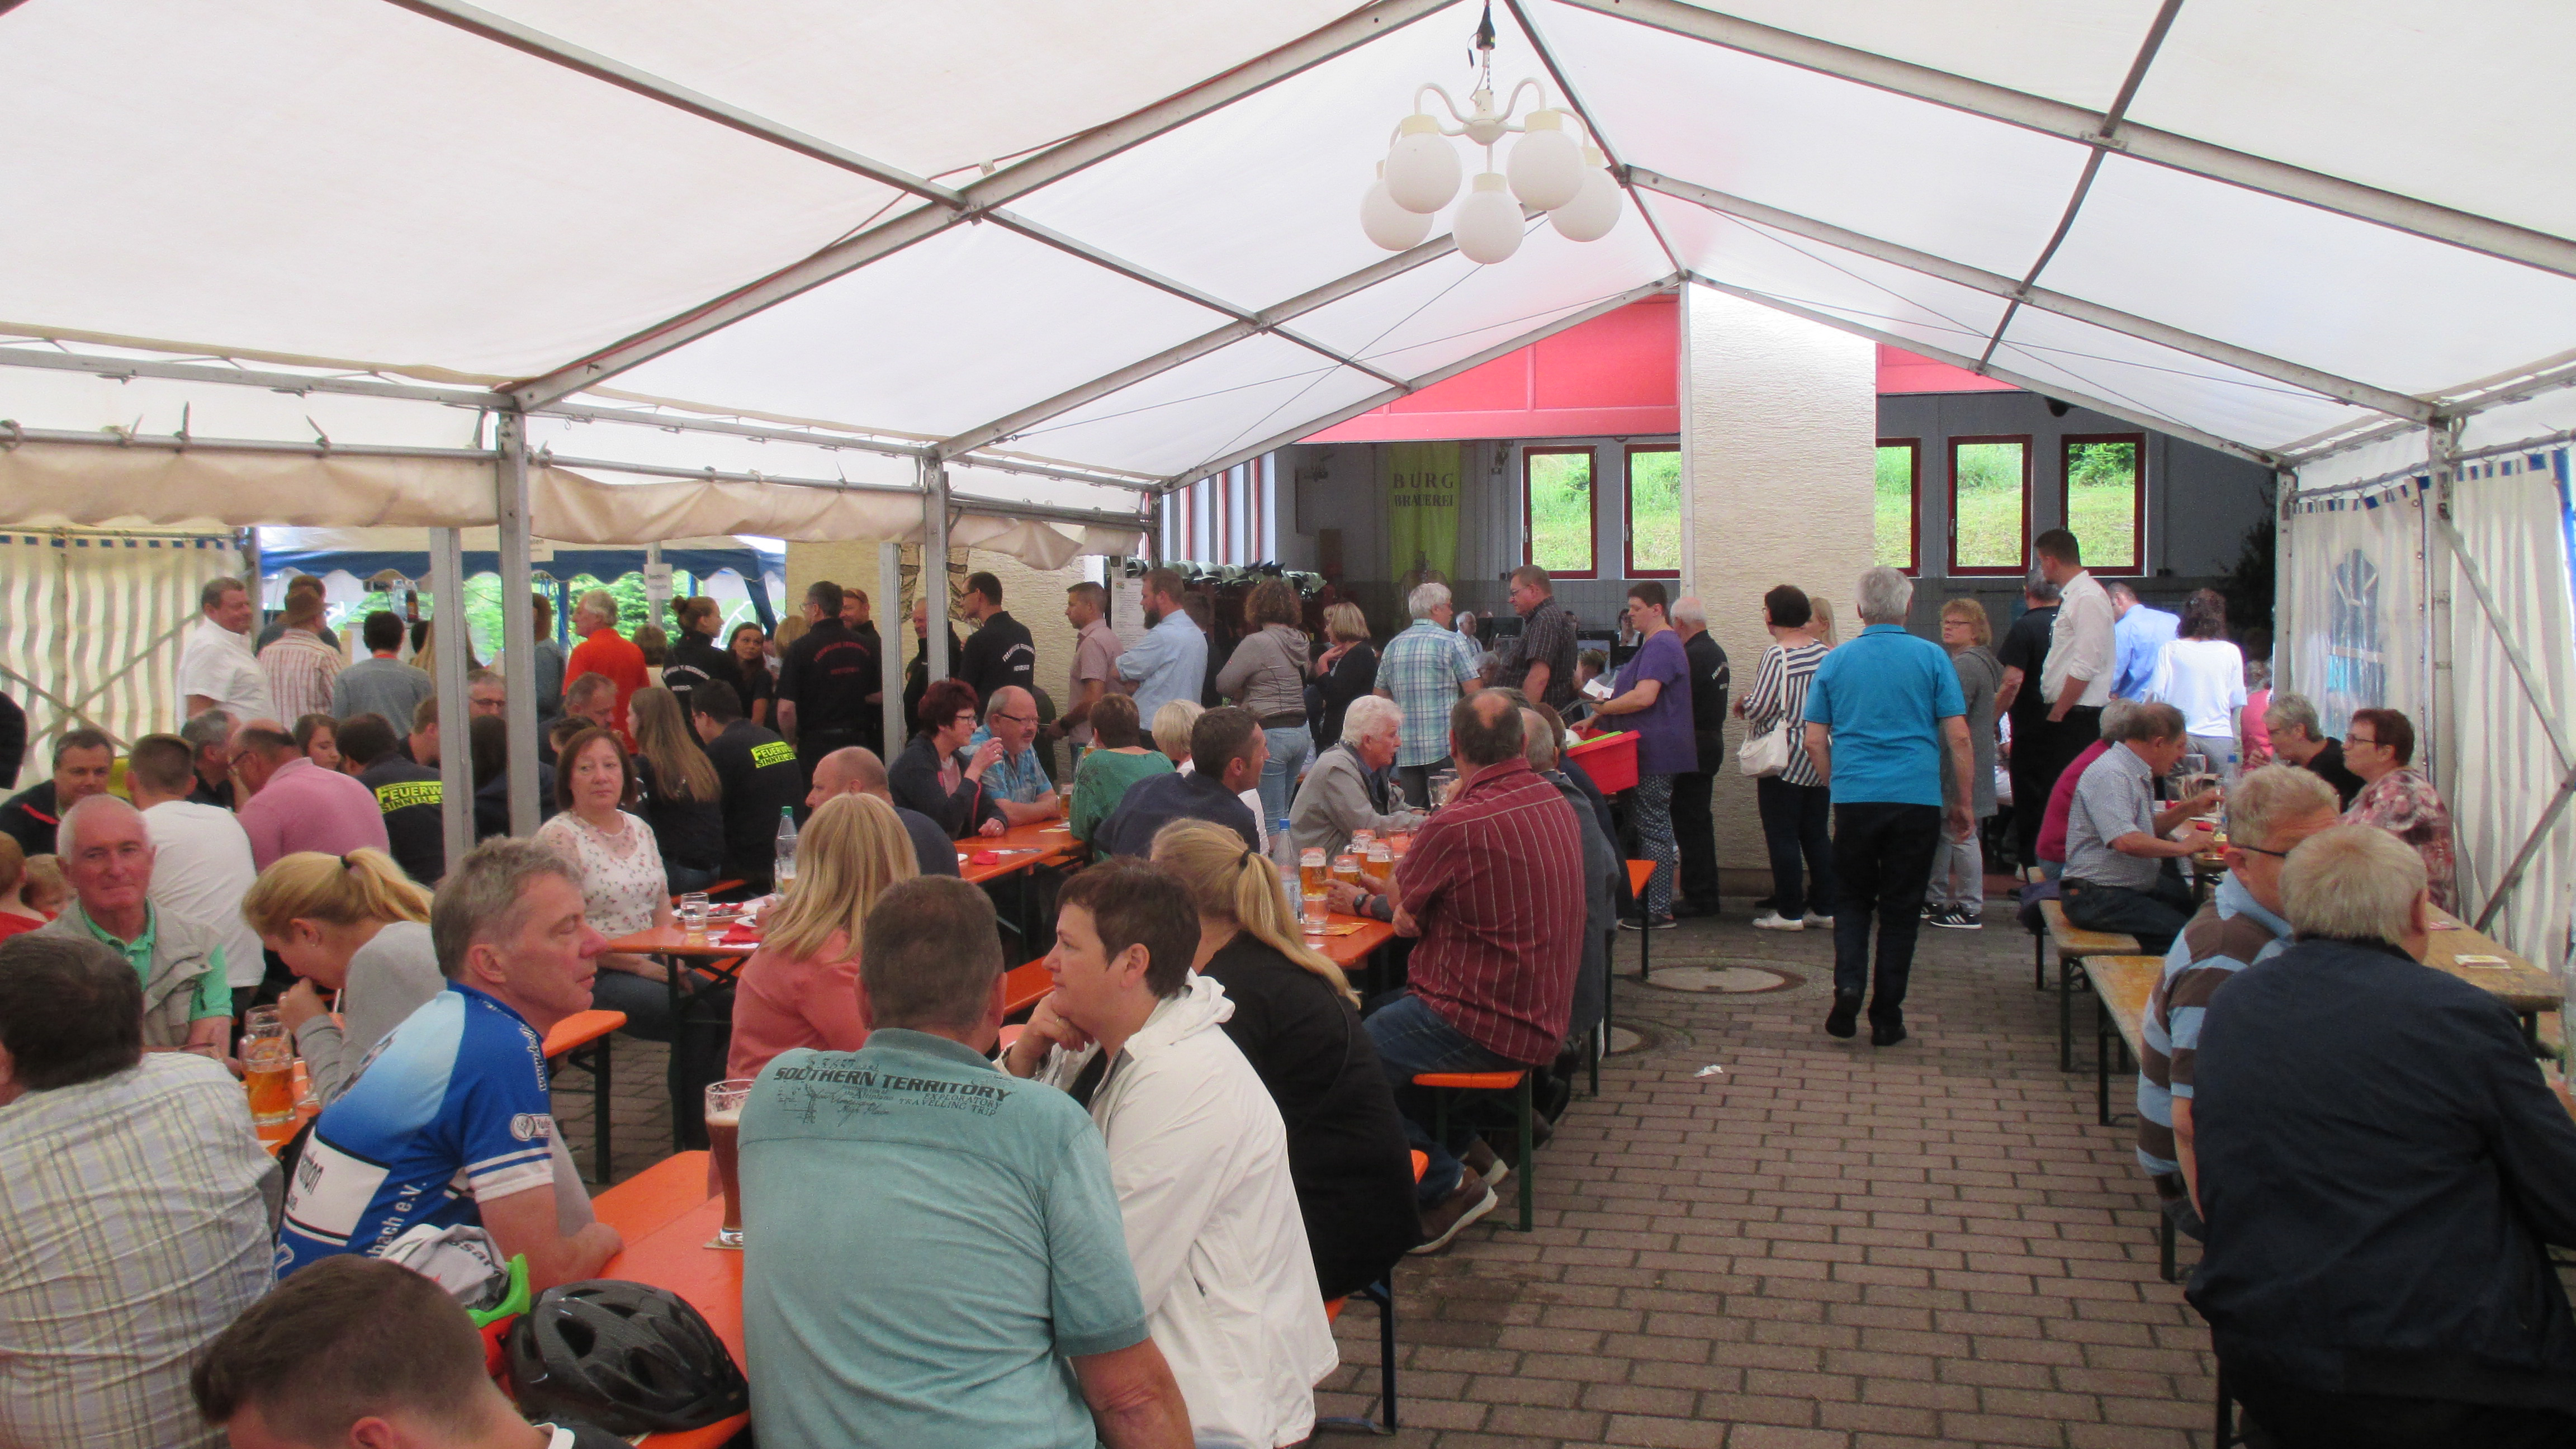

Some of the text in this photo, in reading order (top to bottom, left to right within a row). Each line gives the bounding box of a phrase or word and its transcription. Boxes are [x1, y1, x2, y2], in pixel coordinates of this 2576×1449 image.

[1393, 473, 1453, 489] BURG
[1395, 494, 1453, 506] BRAUEREI
[376, 786, 442, 805] FEUERW
[774, 1067, 877, 1086] SOUTHERN
[882, 1074, 1011, 1101] TERRITORY
[899, 1098, 996, 1116] TRAVELLING TRIP
[924, 1093, 1002, 1109] EXPLORATORY
[367, 1216, 405, 1258] bach
